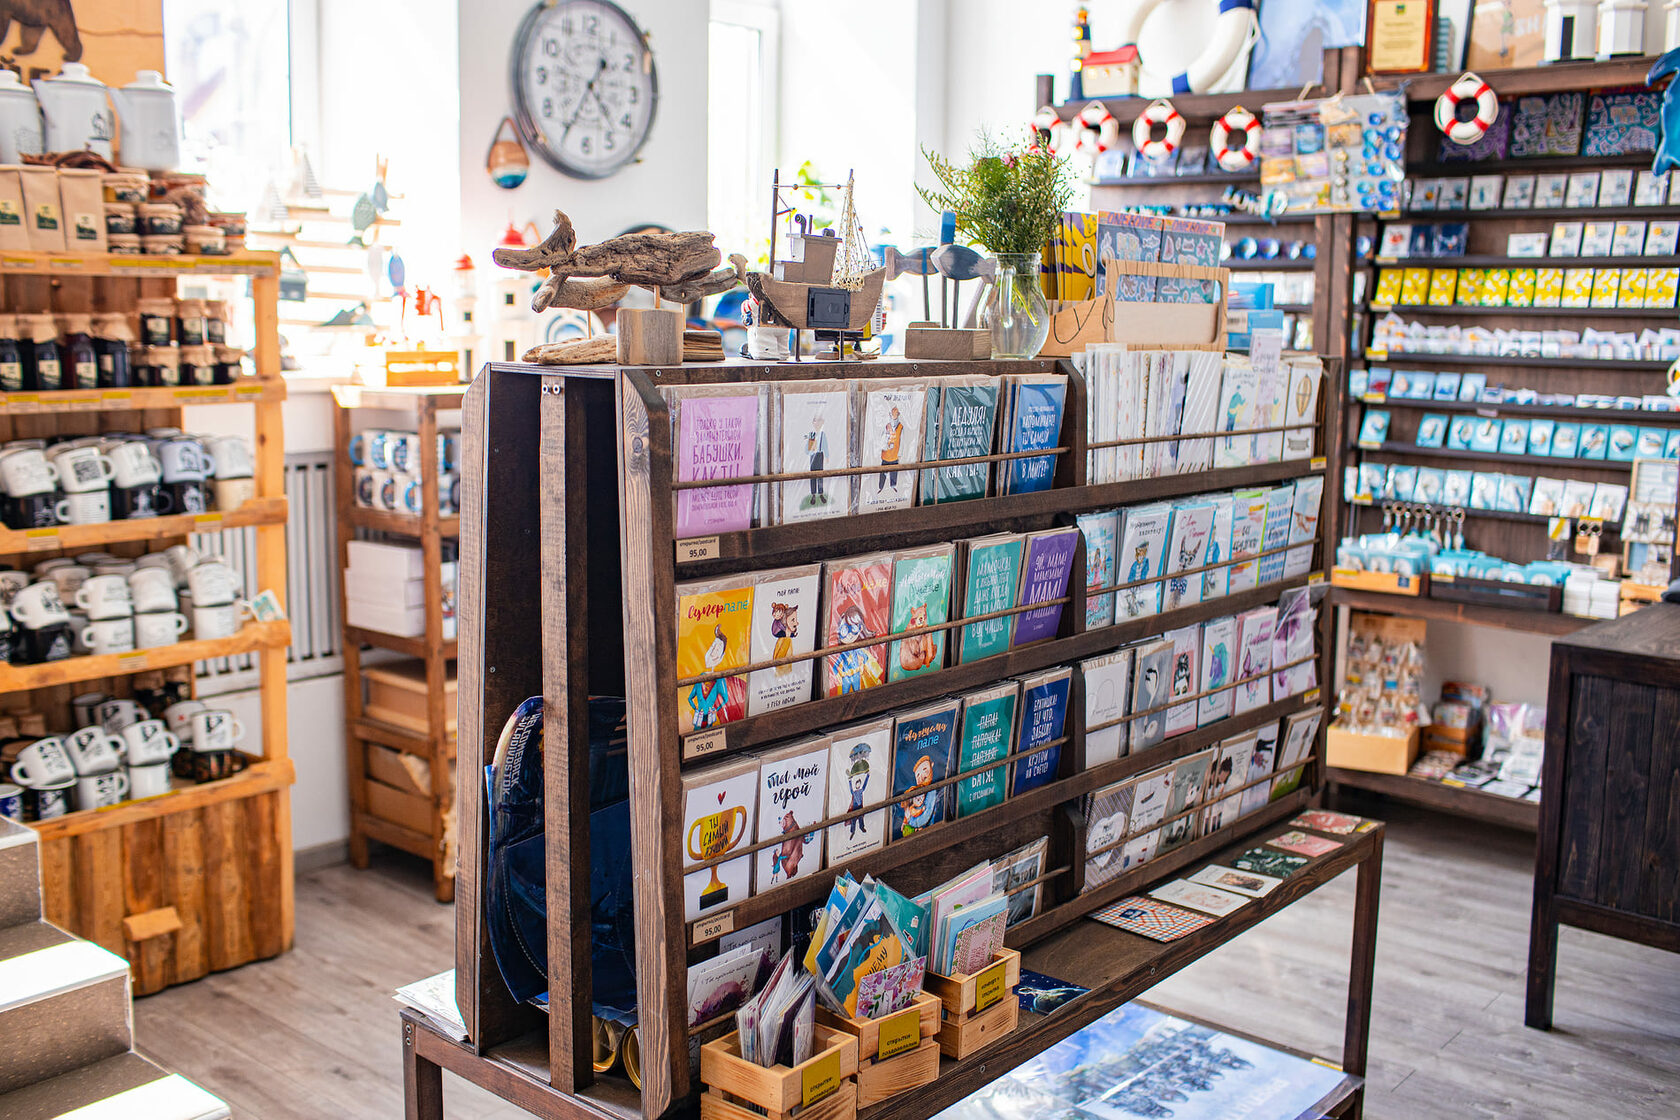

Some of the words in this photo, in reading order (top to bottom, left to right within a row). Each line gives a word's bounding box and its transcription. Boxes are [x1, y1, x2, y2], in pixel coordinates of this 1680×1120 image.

[583, 15, 598, 35] 12
[541, 38, 560, 58] 10
[623, 53, 635, 73] 2
[536, 66, 548, 85] 9
[629, 85, 638, 105] 3
[542, 97, 553, 118] 8
[620, 113, 632, 129] 4
[581, 136, 592, 155] 6
[604, 131, 615, 150] 5
[951, 405, 987, 427] ДЕДУЛЯ!
[693, 442, 744, 465] БАБУШКИ,
[689, 548, 707, 558] 95,00
[1047, 550, 1068, 568] МАМ!
[1029, 578, 1063, 605] МАМ!
[1033, 711, 1042, 726] ТЫ
[696, 741, 714, 752] 95,00
[917, 735, 940, 750] папе
[767, 770, 791, 789] Ты
[793, 763, 820, 780] мой
[773, 781, 812, 810] герой
[709, 815, 719, 829] ТЫ
[704, 834, 729, 858] ЛУЧШИЙ
[704, 924, 722, 937] 95,00
